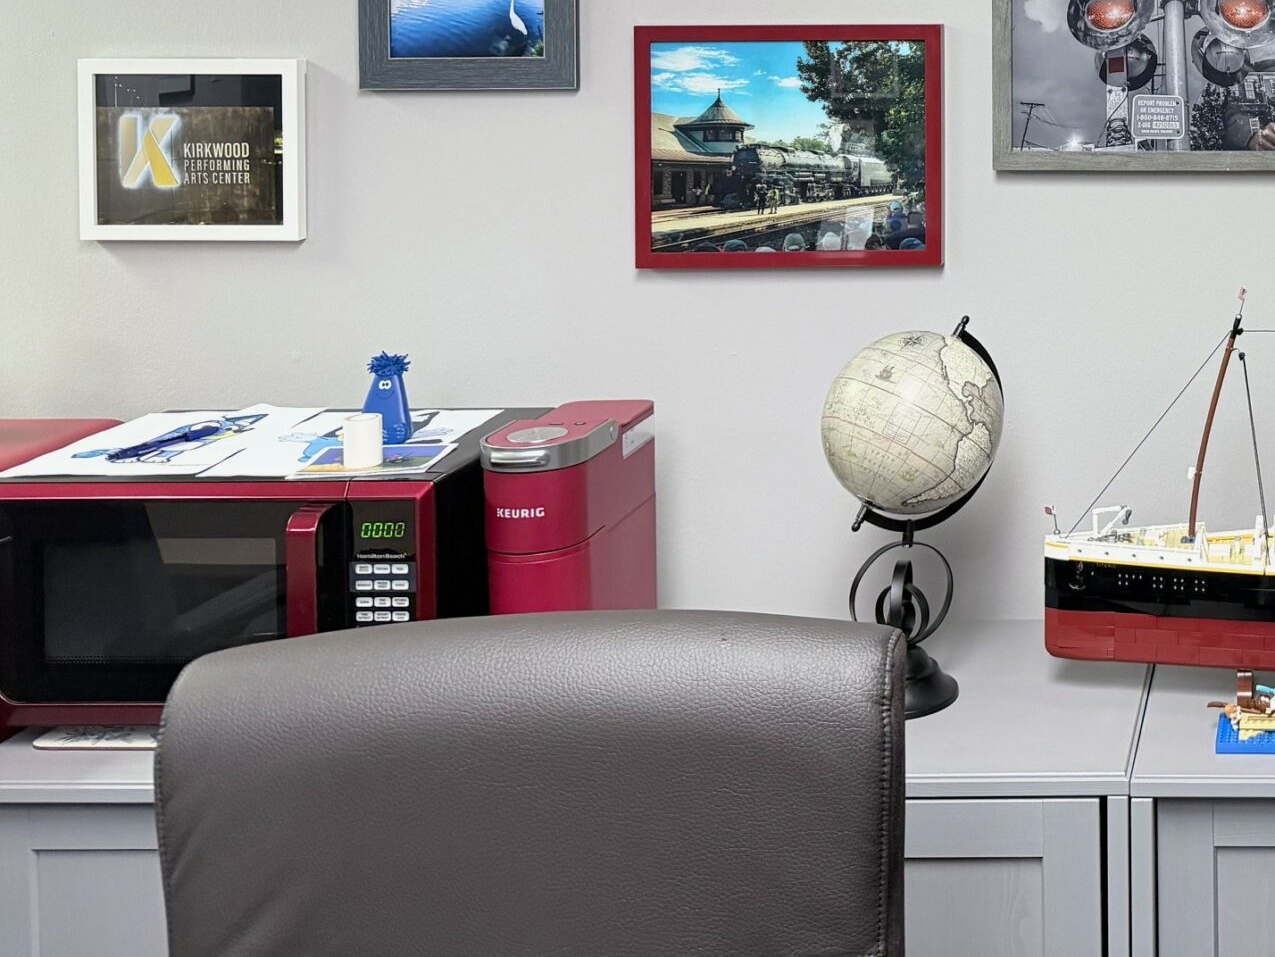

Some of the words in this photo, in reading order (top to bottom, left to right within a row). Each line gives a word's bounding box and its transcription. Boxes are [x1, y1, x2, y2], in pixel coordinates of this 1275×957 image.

[183, 142, 250, 158] KIRKWOOD
[184, 159, 250, 171] PERFORMING
[183, 172, 209, 185] ARTS
[212, 172, 250, 184] CENTER
[496, 507, 545, 518] KEURIG
[360, 522, 405, 538] 0000
